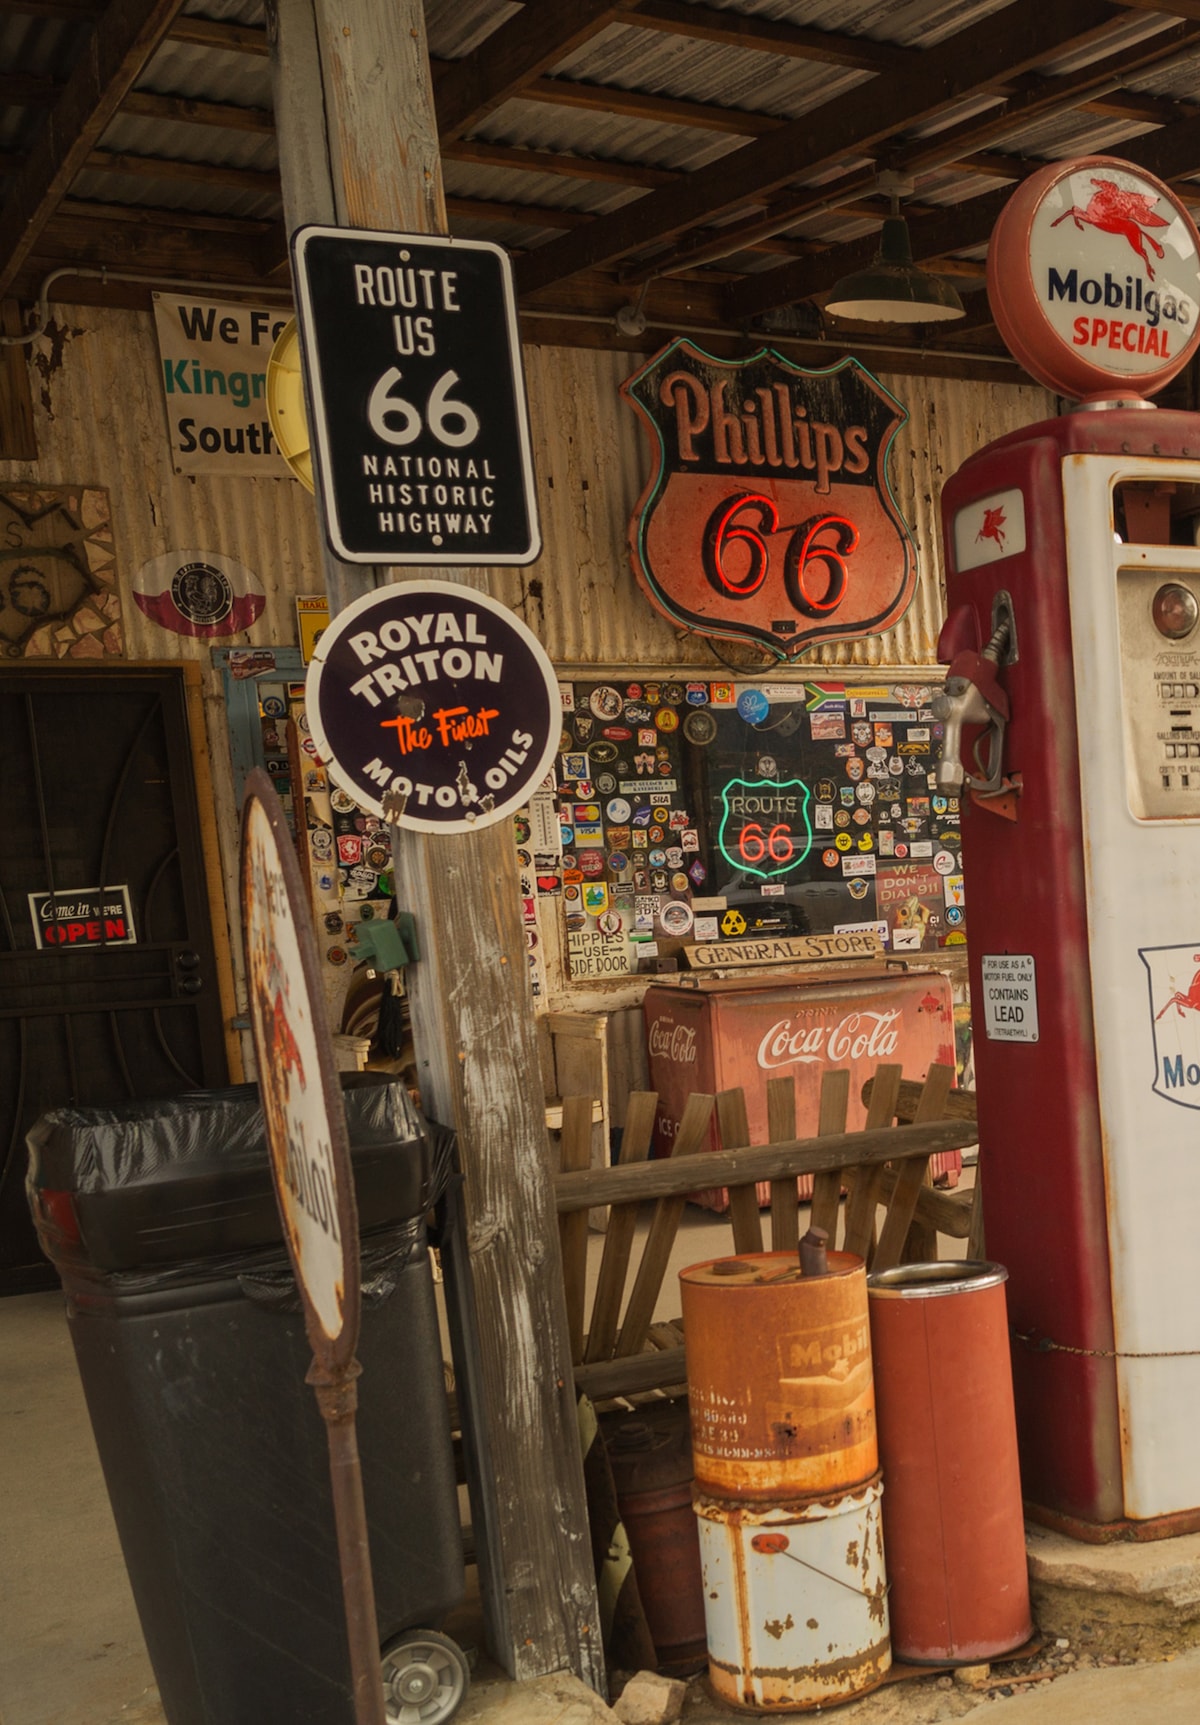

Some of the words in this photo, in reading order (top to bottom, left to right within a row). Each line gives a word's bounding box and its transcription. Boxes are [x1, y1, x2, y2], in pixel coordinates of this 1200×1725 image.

[355, 264, 461, 312] ROUTE
[1048, 267, 1191, 327] Mobilgas
[177, 305, 240, 344] We
[394, 315, 436, 357] US
[1072, 316, 1172, 359] SPECIAL
[367, 366, 480, 448] 66
[660, 370, 870, 494] Phillips
[363, 455, 497, 481] NATIONAL
[369, 484, 496, 508] HISTORIC
[379, 512, 492, 535] HIGHWAY
[701, 489, 861, 619] 66
[348, 612, 487, 667] ROYAL
[349, 647, 504, 708] TRITON
[379, 715, 433, 756] The
[432, 706, 500, 748] Finest
[361, 757, 480, 808] MOTOR
[485, 728, 534, 790] OILS
[731, 796, 798, 815] ROUTE
[739, 823, 794, 863] 66
[883, 873, 930, 890] DON'T
[892, 864, 919, 876] WE
[880, 888, 911, 902] DIAL
[917, 883, 938, 895] 911
[77, 901, 91, 915] in
[45, 918, 126, 945] OPEN
[567, 929, 625, 947] HIPPIES
[583, 945, 609, 958] USE
[694, 941, 800, 966] GENERAL
[804, 936, 878, 961] STORE
[987, 960, 998, 969] FOR
[998, 960, 1009, 969] USE
[1010, 960, 1019, 969] AS
[1020, 961, 1026, 969] A
[569, 959, 594, 976] SIDE
[596, 955, 628, 973] DOOR
[984, 972, 1000, 981] MOTOR
[1001, 973, 1016, 982] FUEL
[1017, 973, 1033, 982] ONLY
[989, 987, 1029, 1001] CONTAINS
[994, 1005, 1025, 1023] LEAD
[757, 1008, 903, 1070] Coca-Cola
[658, 1116, 673, 1135] ICE
[790, 1324, 868, 1369] Mobil
